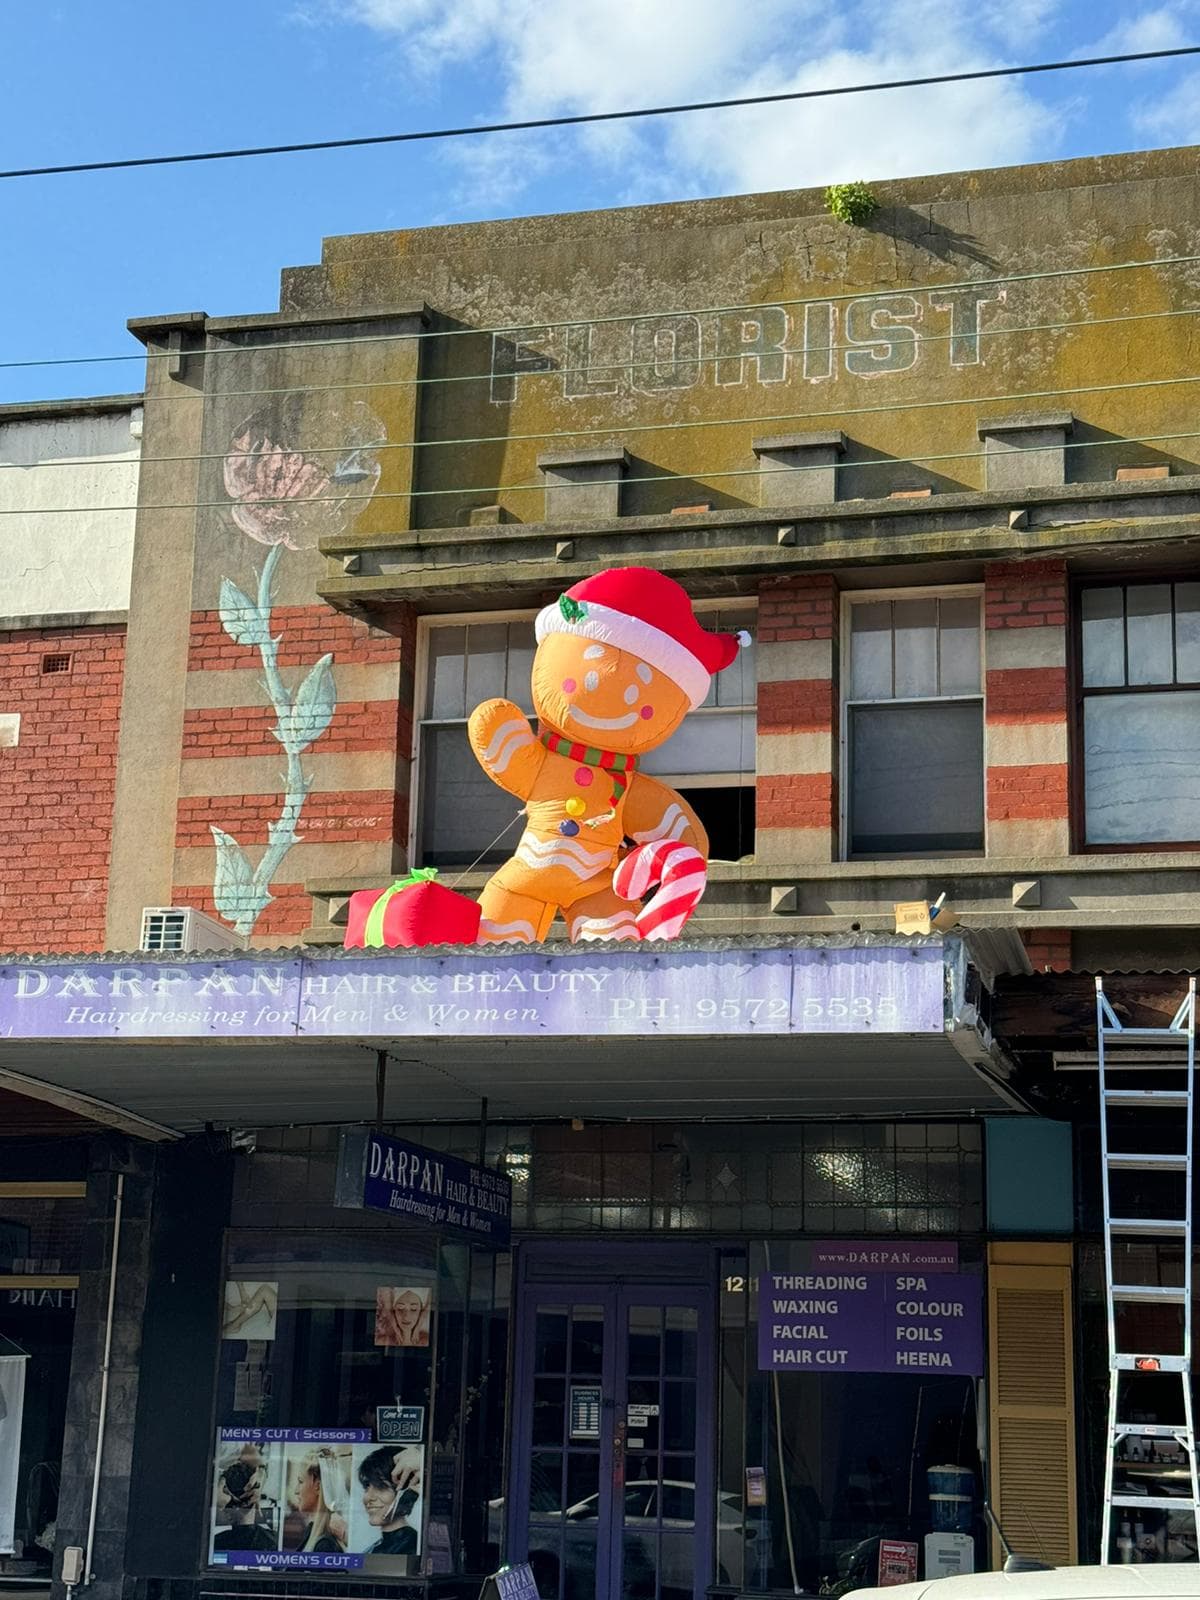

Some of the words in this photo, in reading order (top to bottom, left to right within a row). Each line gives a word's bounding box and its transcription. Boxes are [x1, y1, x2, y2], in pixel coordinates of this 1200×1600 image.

[490, 290, 1006, 404] FLORIST
[14, 967, 287, 998] DARPAN
[303, 975, 398, 994] HAIR
[411, 976, 438, 994] &
[450, 973, 611, 994] BEAUTY
[65, 1006, 248, 1026] Hairdressing
[254, 1006, 297, 1026] for
[301, 1005, 369, 1023] Men
[384, 1004, 409, 1022] &
[428, 1004, 539, 1022] Women
[609, 998, 681, 1019] PH:
[696, 998, 789, 1020] 9572
[803, 996, 898, 1018] 5535
[369, 1141, 444, 1197] DARPAN
[446, 1179, 468, 1205] HAIR
[468, 1186, 476, 1207] &
[477, 1189, 510, 1217] BEAUTY
[389, 1189, 436, 1222] Hairdressing
[818, 1252, 955, 1265] www.DARPAN.com.au
[772, 1275, 868, 1291] THREADING
[895, 1276, 928, 1292] SPA
[772, 1300, 839, 1315] WAXING
[895, 1301, 964, 1317] COLOUR
[772, 1325, 829, 1340] FACIAL
[895, 1326, 944, 1342] FOILS
[772, 1349, 813, 1364] HAIR
[815, 1350, 849, 1365] CUT
[895, 1351, 953, 1367] HEENA
[221, 1428, 262, 1439] MEN'S
[265, 1429, 291, 1440] CUT
[303, 1429, 357, 1440] Scissors
[380, 1420, 420, 1437] OPEN
[255, 1554, 320, 1566] WOMEN'S
[324, 1555, 351, 1567] CUT
